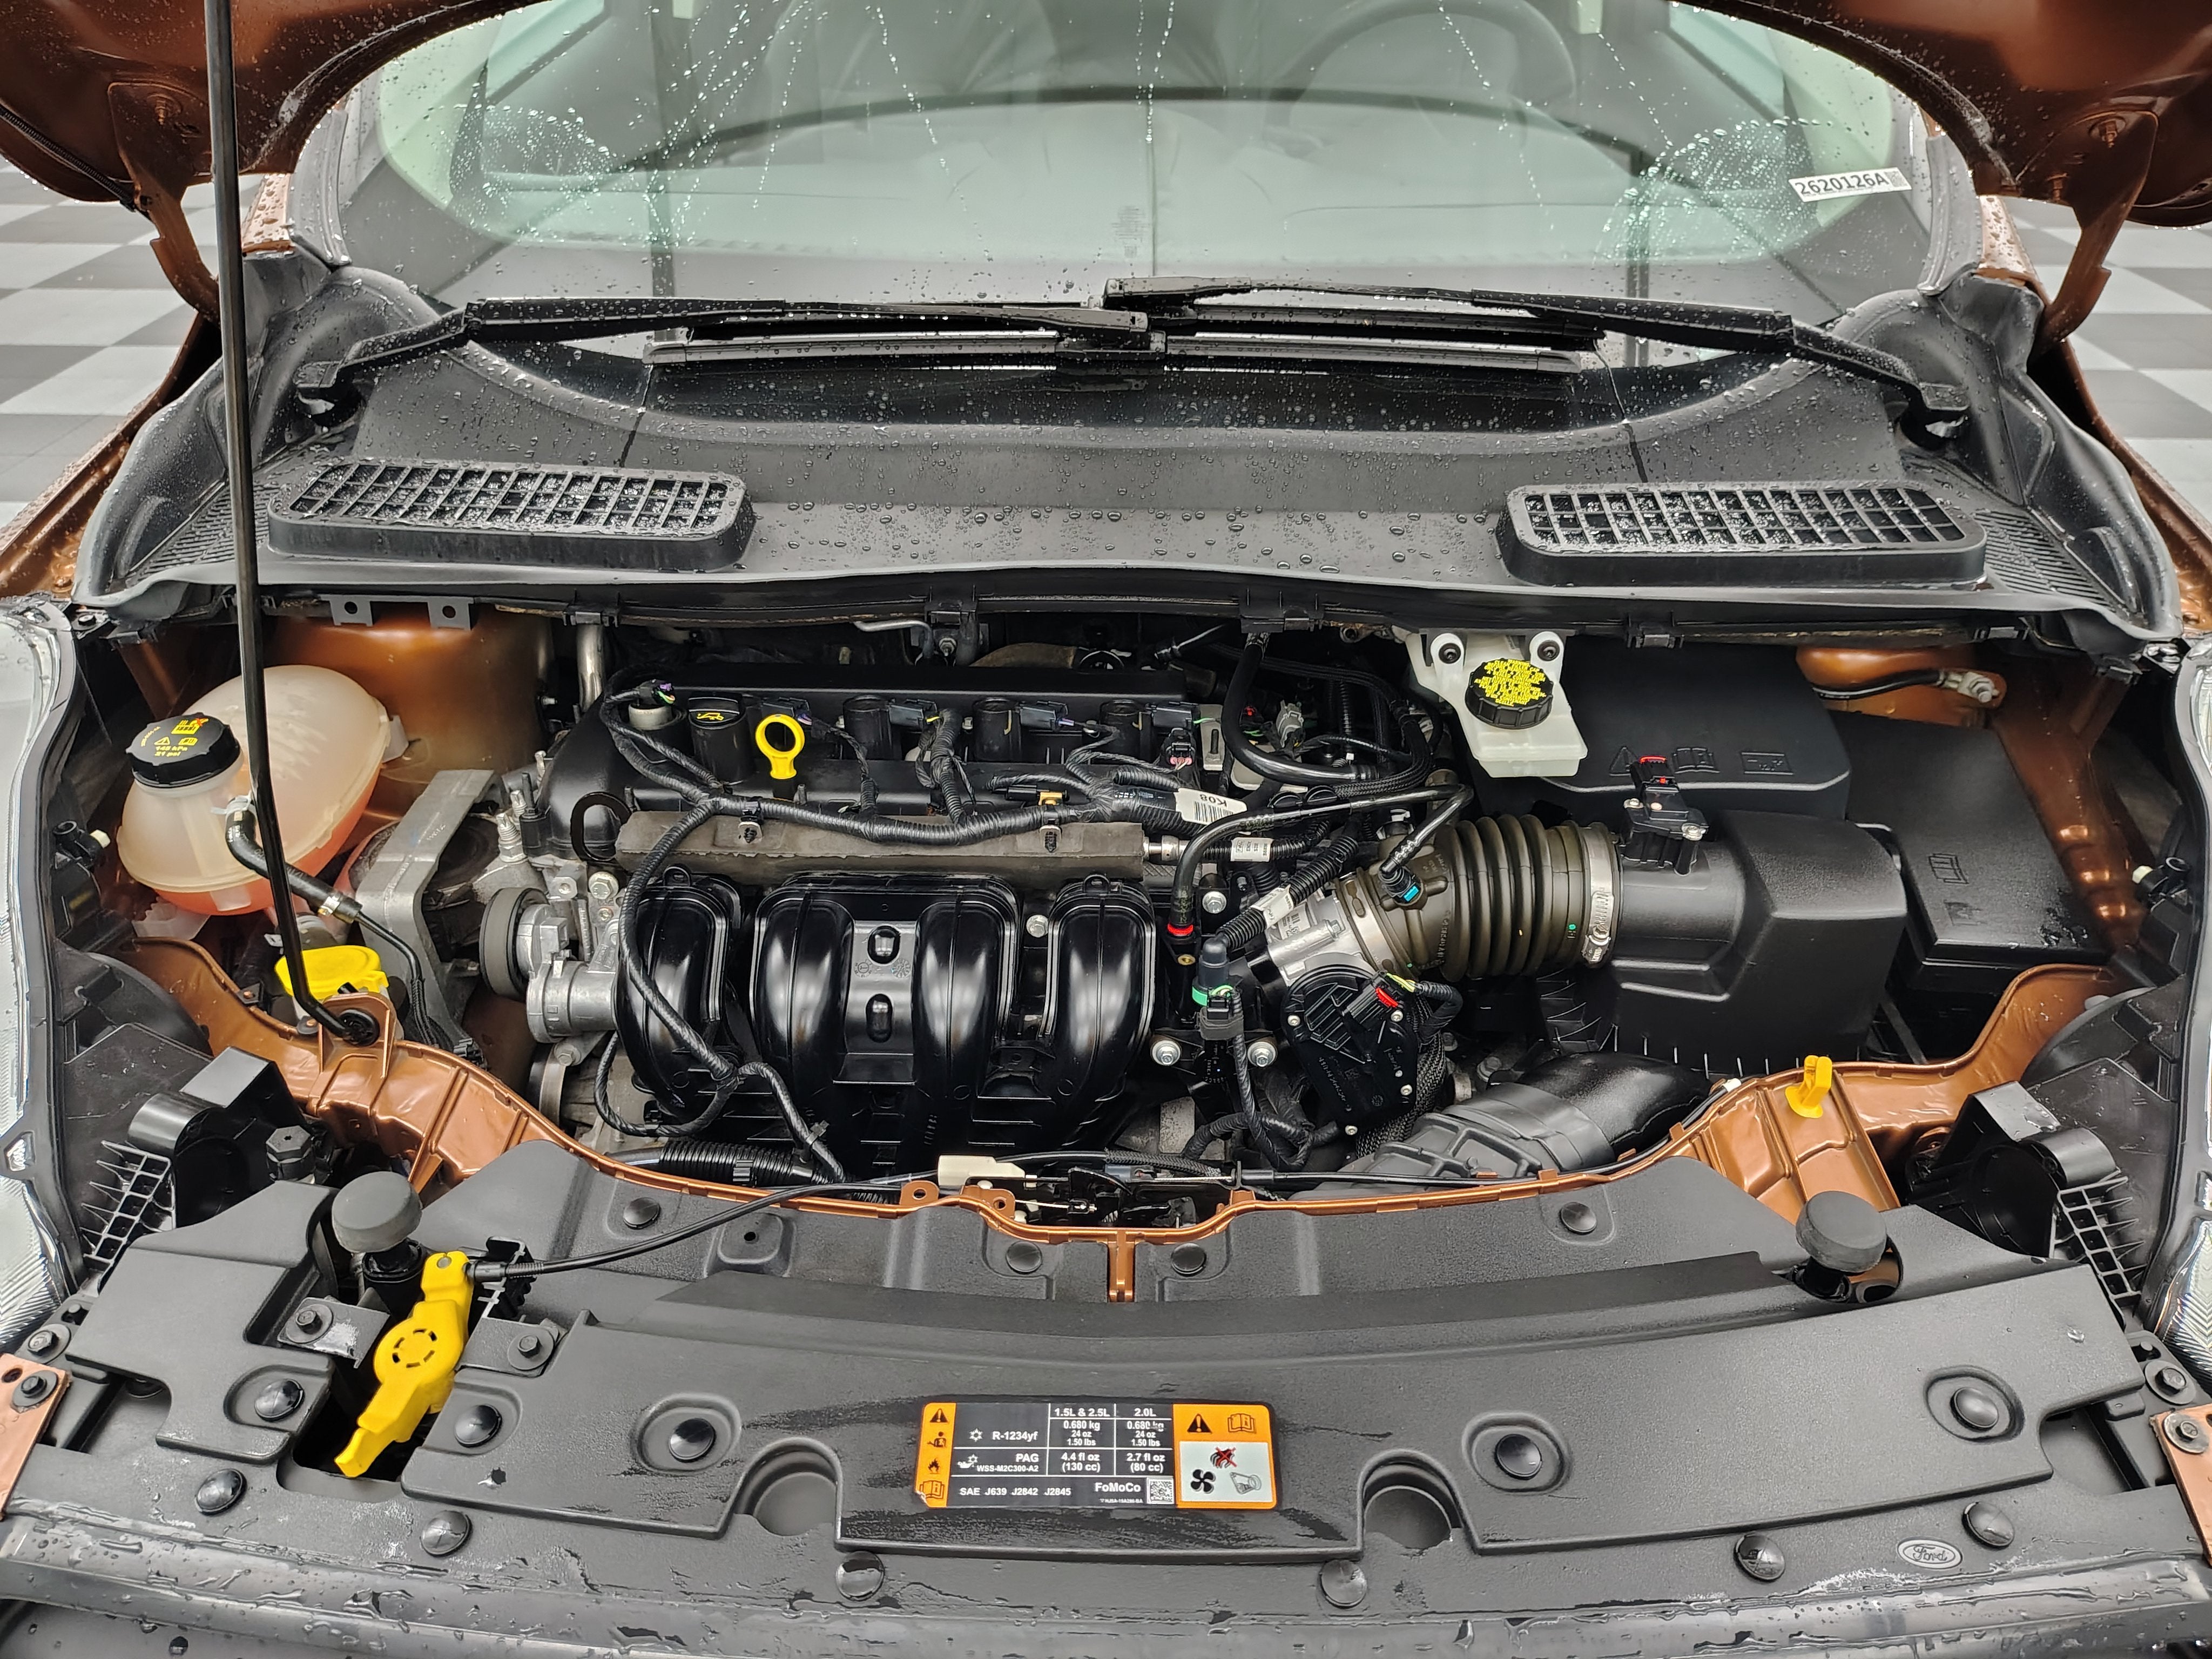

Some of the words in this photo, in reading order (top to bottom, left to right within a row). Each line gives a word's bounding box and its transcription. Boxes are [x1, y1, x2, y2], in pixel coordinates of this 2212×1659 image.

[1795, 172, 1890, 195] 2620126A
[1054, 1408, 1076, 1417] 1.5L
[1078, 1408, 1086, 1417] &
[1088, 1408, 1110, 1417] 2.5L
[1134, 1408, 1156, 1417] 2.0L
[1063, 1420, 1087, 1429] 0.680
[1089, 1420, 1100, 1431] kg
[1127, 1421, 1150, 1429] 0.680
[992, 1431, 1038, 1442] R-1234yf
[1016, 1453, 1039, 1462] PAG
[1061, 1452, 1076, 1461] 4.4
[1078, 1452, 1085, 1461] fl
[1127, 1453, 1142, 1461] 2.7
[1144, 1453, 1151, 1461] fl
[1062, 1462, 1083, 1473] (130
[1085, 1463, 1101, 1473] cc)
[1130, 1463, 1146, 1473] (80
[1148, 1464, 1163, 1473] cc)
[959, 1487, 981, 1495] SAE
[984, 1487, 1007, 1495] J639
[1011, 1487, 1038, 1495] J2842
[1044, 1487, 1071, 1496] J2845
[1095, 1482, 1141, 1492] FoMoCo
[1913, 1545, 1947, 1561] Ford
